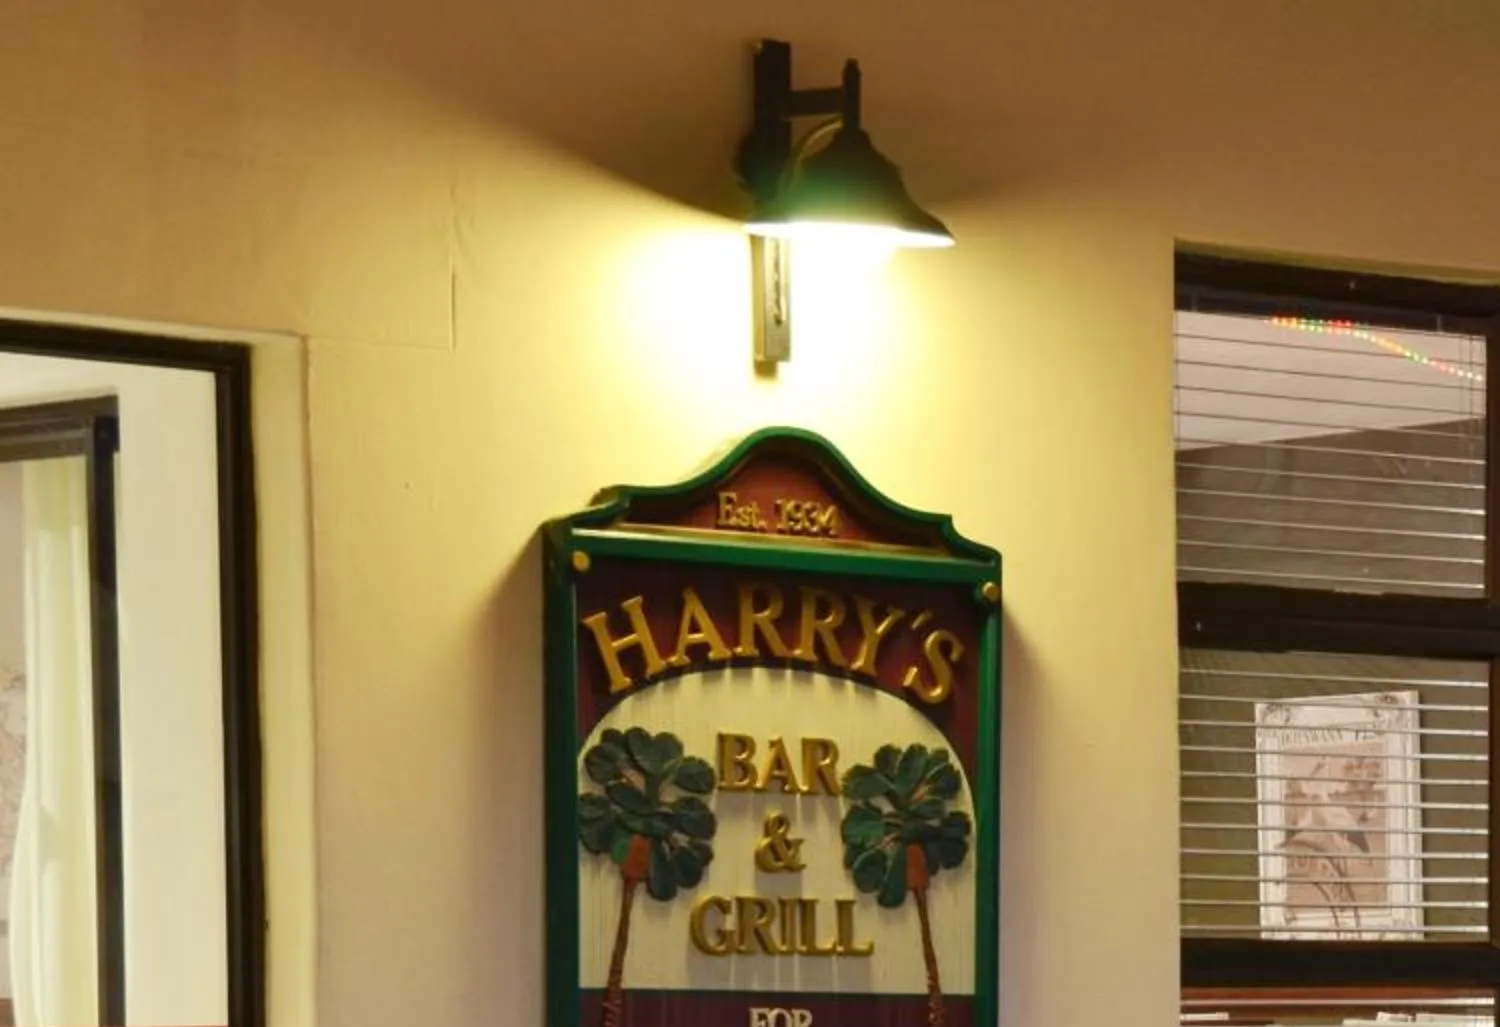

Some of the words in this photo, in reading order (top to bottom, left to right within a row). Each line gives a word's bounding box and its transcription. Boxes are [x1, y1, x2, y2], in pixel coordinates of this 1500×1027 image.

[717, 491, 767, 529] Est.
[583, 584, 964, 703] HARRY'S
[716, 732, 842, 796] BAR
[755, 809, 805, 873] &
[689, 896, 873, 956] GRILL
